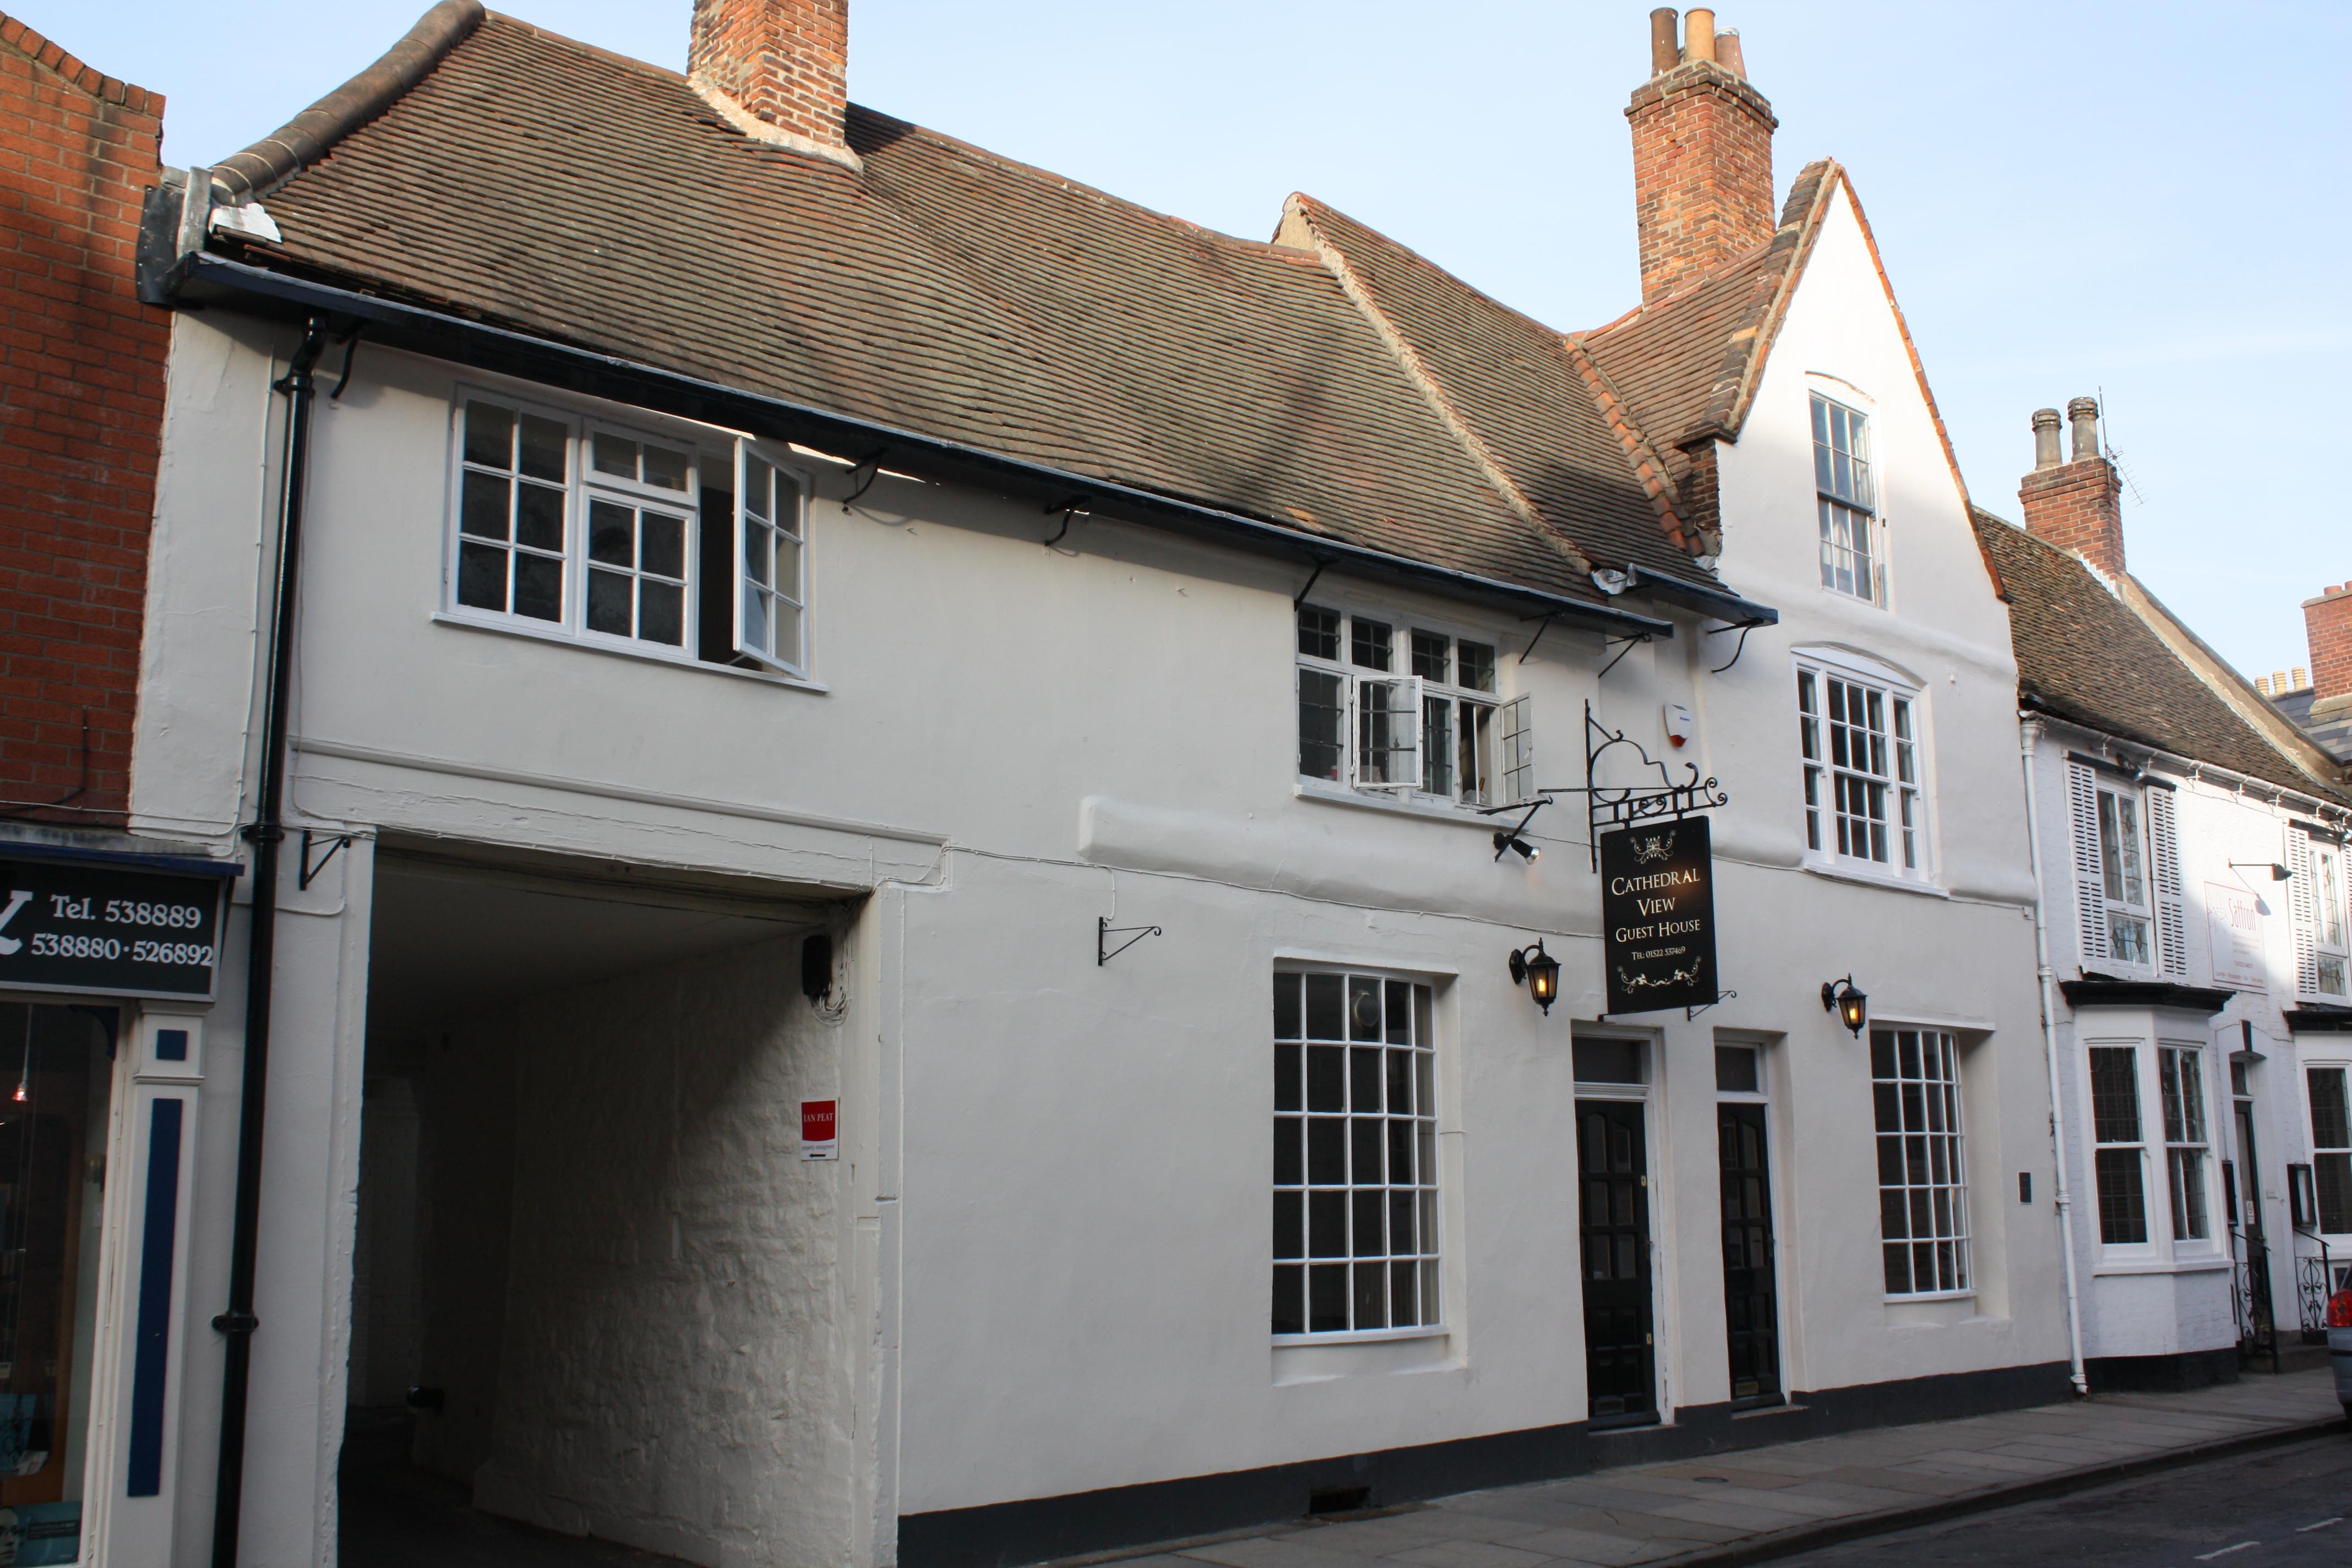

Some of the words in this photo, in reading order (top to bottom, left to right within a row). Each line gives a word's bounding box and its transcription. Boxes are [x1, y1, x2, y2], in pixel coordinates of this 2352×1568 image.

[50, 894, 96, 921] Tel.
[104, 900, 202, 929] 538889
[2228, 897, 2257, 932] Saffron
[1646, 949, 1663, 958] 01522
[1664, 946, 1686, 956] 537469
[804, 1114, 815, 1122] IAN
[818, 1113, 834, 1121] PEAT
